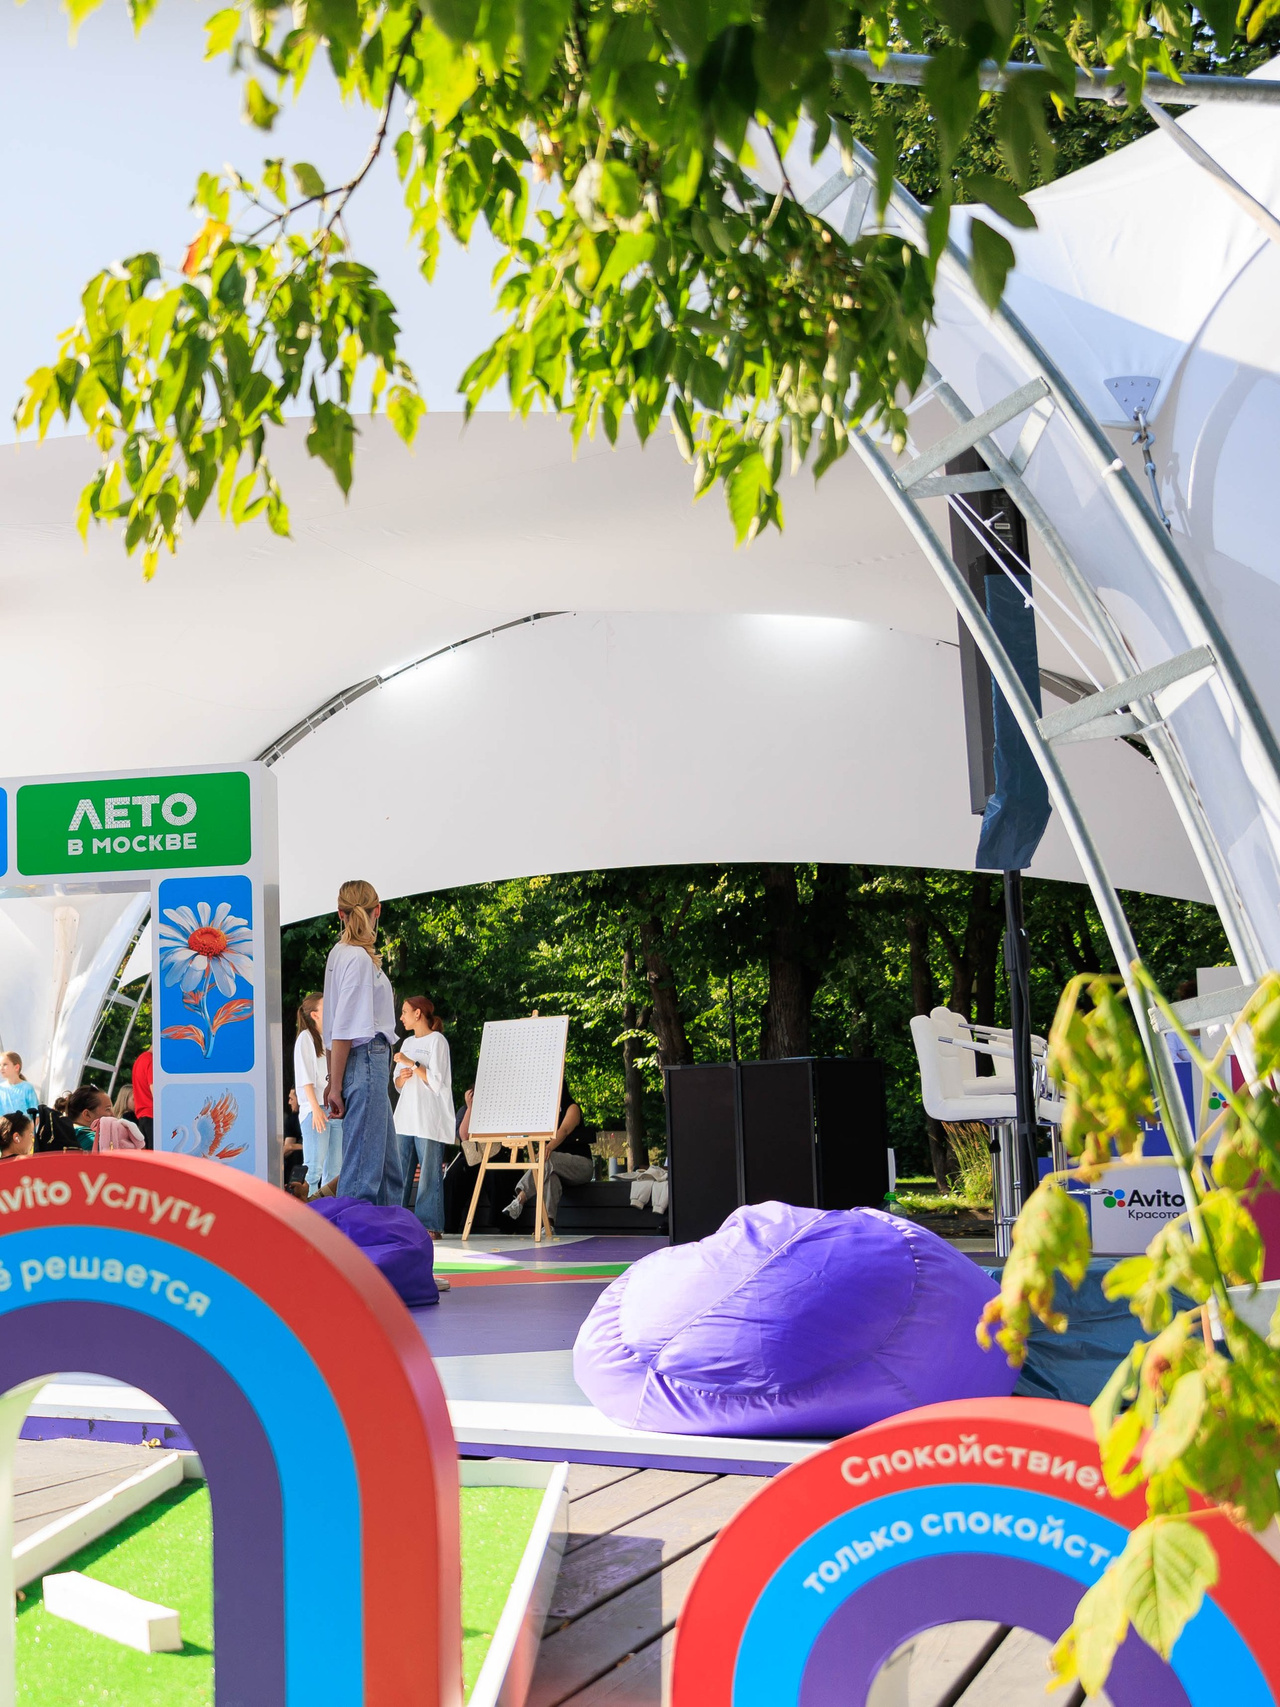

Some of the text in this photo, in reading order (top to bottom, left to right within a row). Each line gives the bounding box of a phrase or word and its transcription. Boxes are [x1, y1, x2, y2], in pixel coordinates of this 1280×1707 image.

[68, 792, 197, 831] ЛЕТО
[67, 832, 197, 856] В МОСКВЕ
[79, 1171, 217, 1237] Услуги
[1127, 1189, 1186, 1207] Avito
[1128, 1209, 1181, 1221] Красота
[20, 1255, 212, 1318] решается
[840, 1434, 1107, 1499] Спокойствие,
[803, 1509, 1119, 1594] только спокойст
